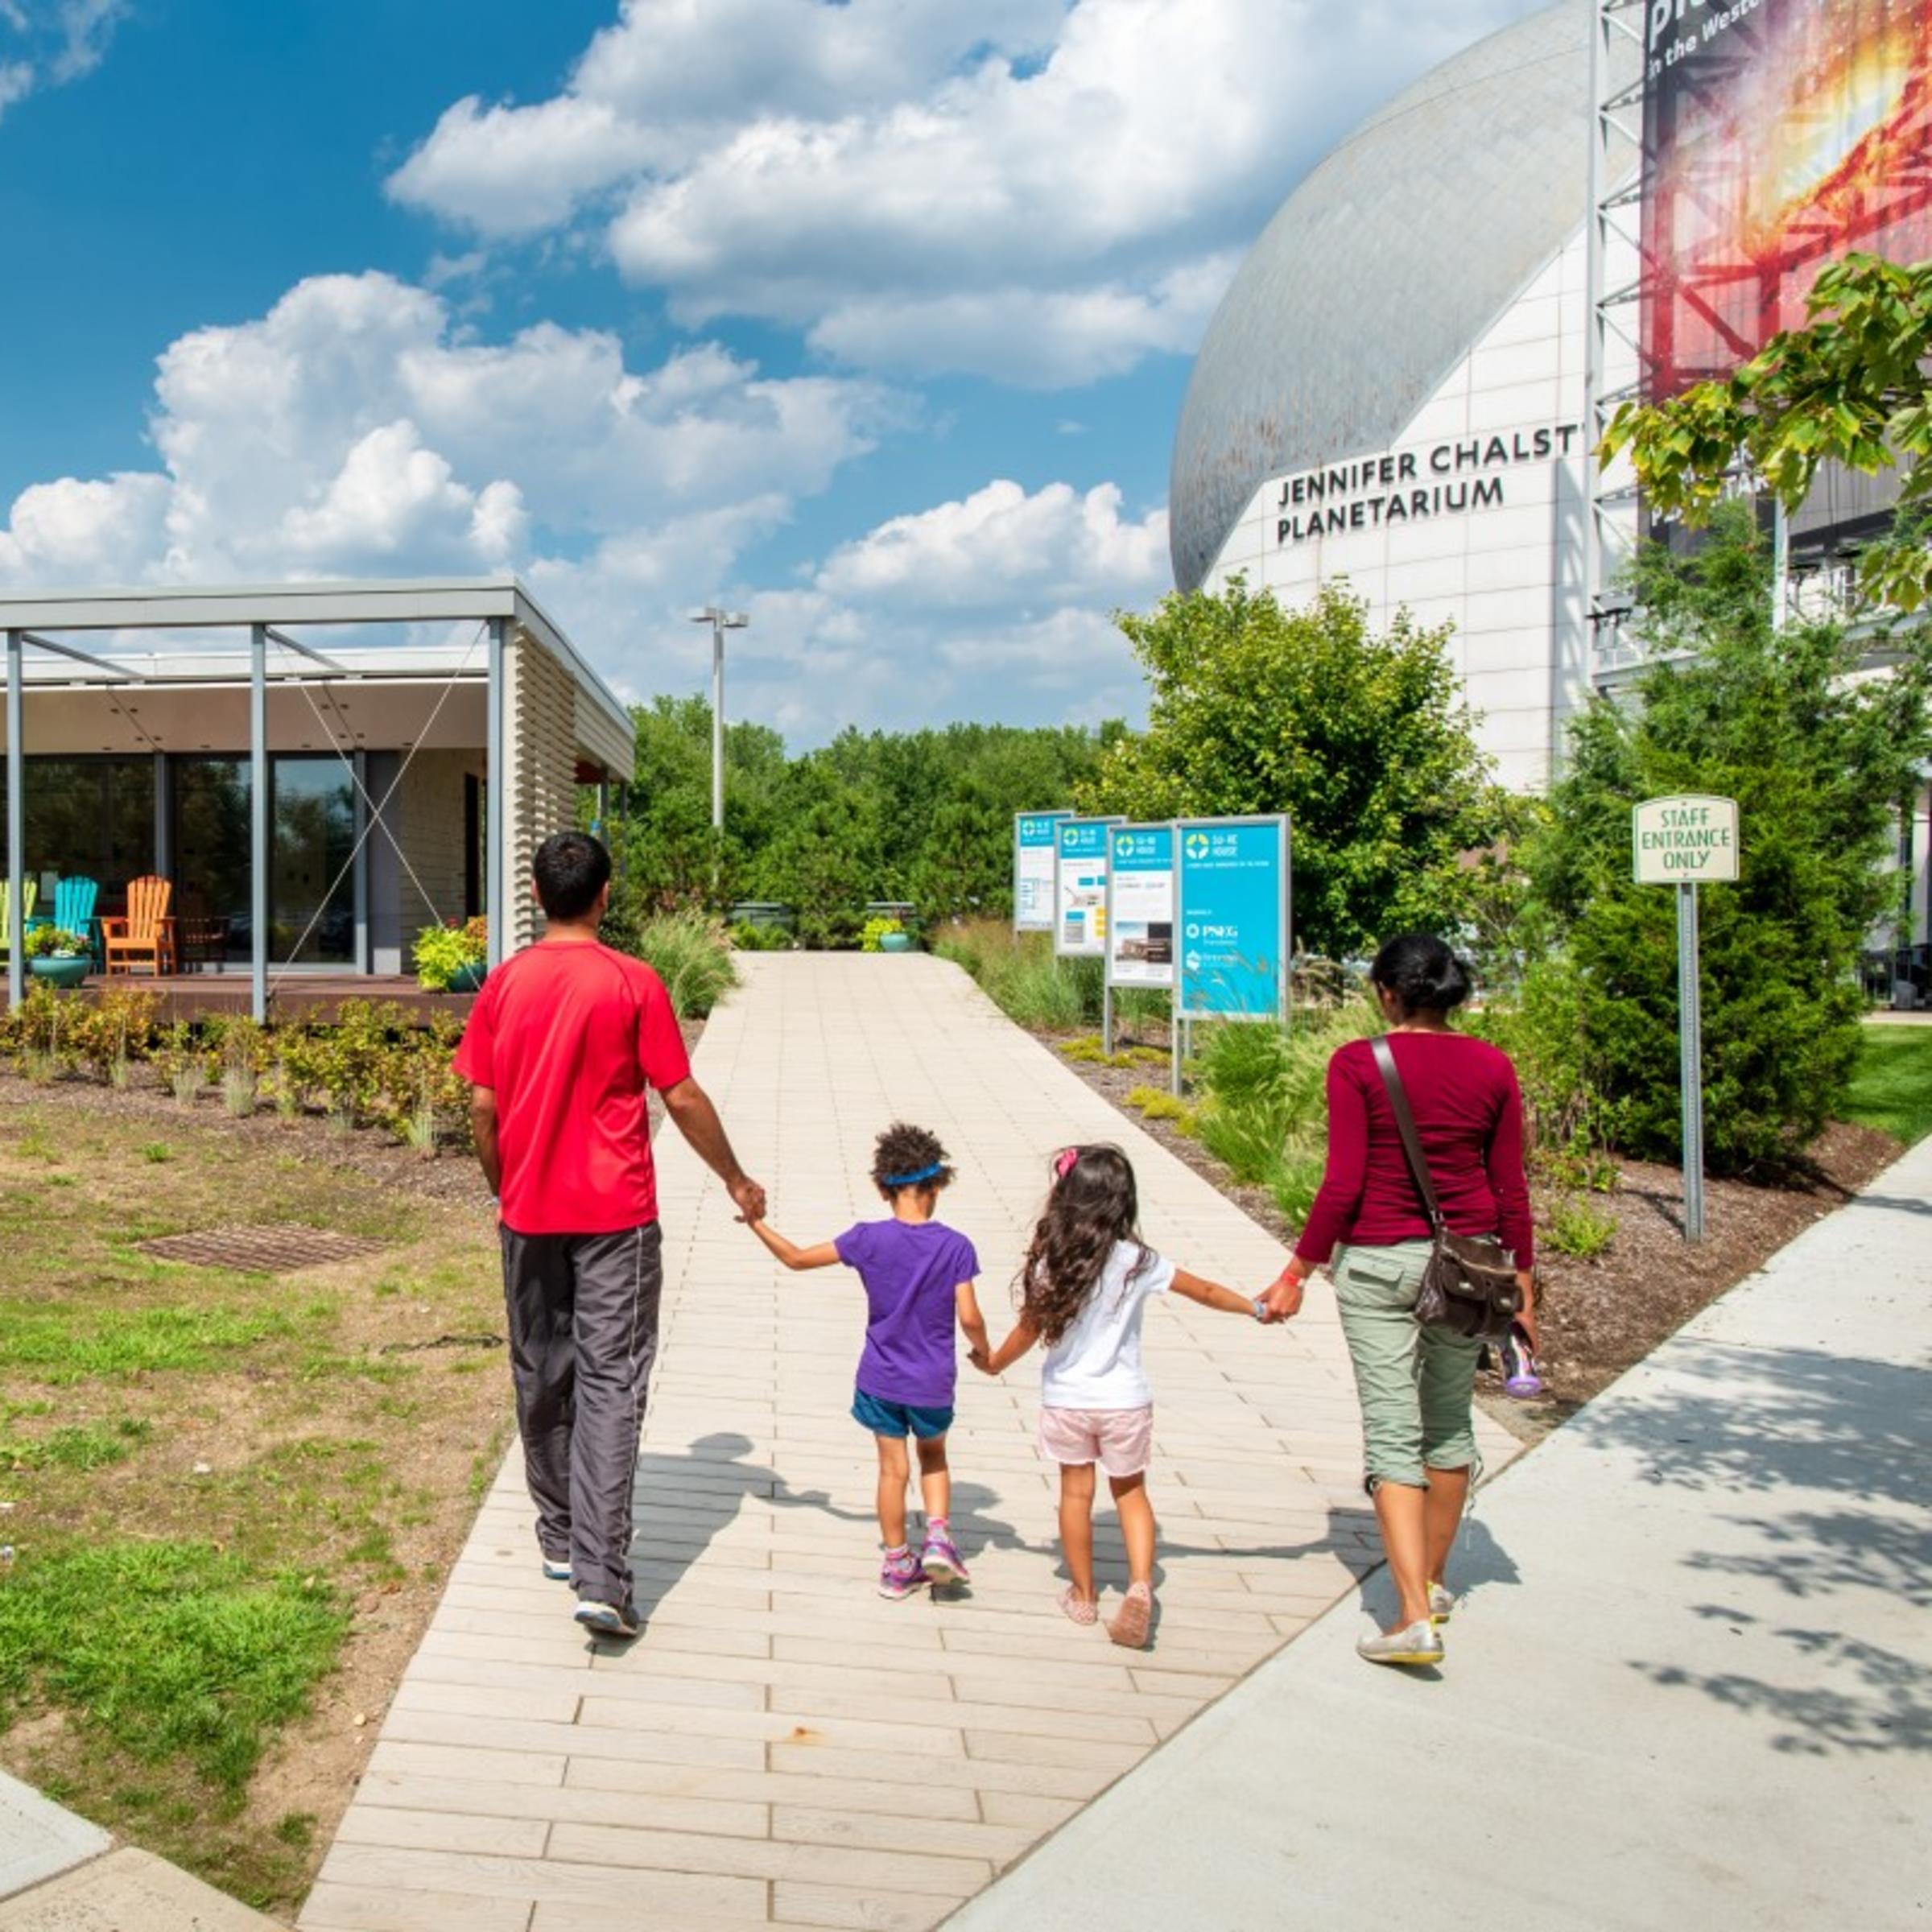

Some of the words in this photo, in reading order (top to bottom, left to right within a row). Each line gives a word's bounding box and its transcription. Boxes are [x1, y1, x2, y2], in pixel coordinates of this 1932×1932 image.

[1664, 35, 1697, 66] the
[1278, 452, 1417, 507] JENNIFER
[1430, 423, 1585, 473] CHALST
[1278, 477, 1504, 543] PLANETARIUM
[1661, 807, 1710, 828] STAFF
[1641, 828, 1730, 849] ENTRANCE
[1663, 850, 1711, 869] ONLY
